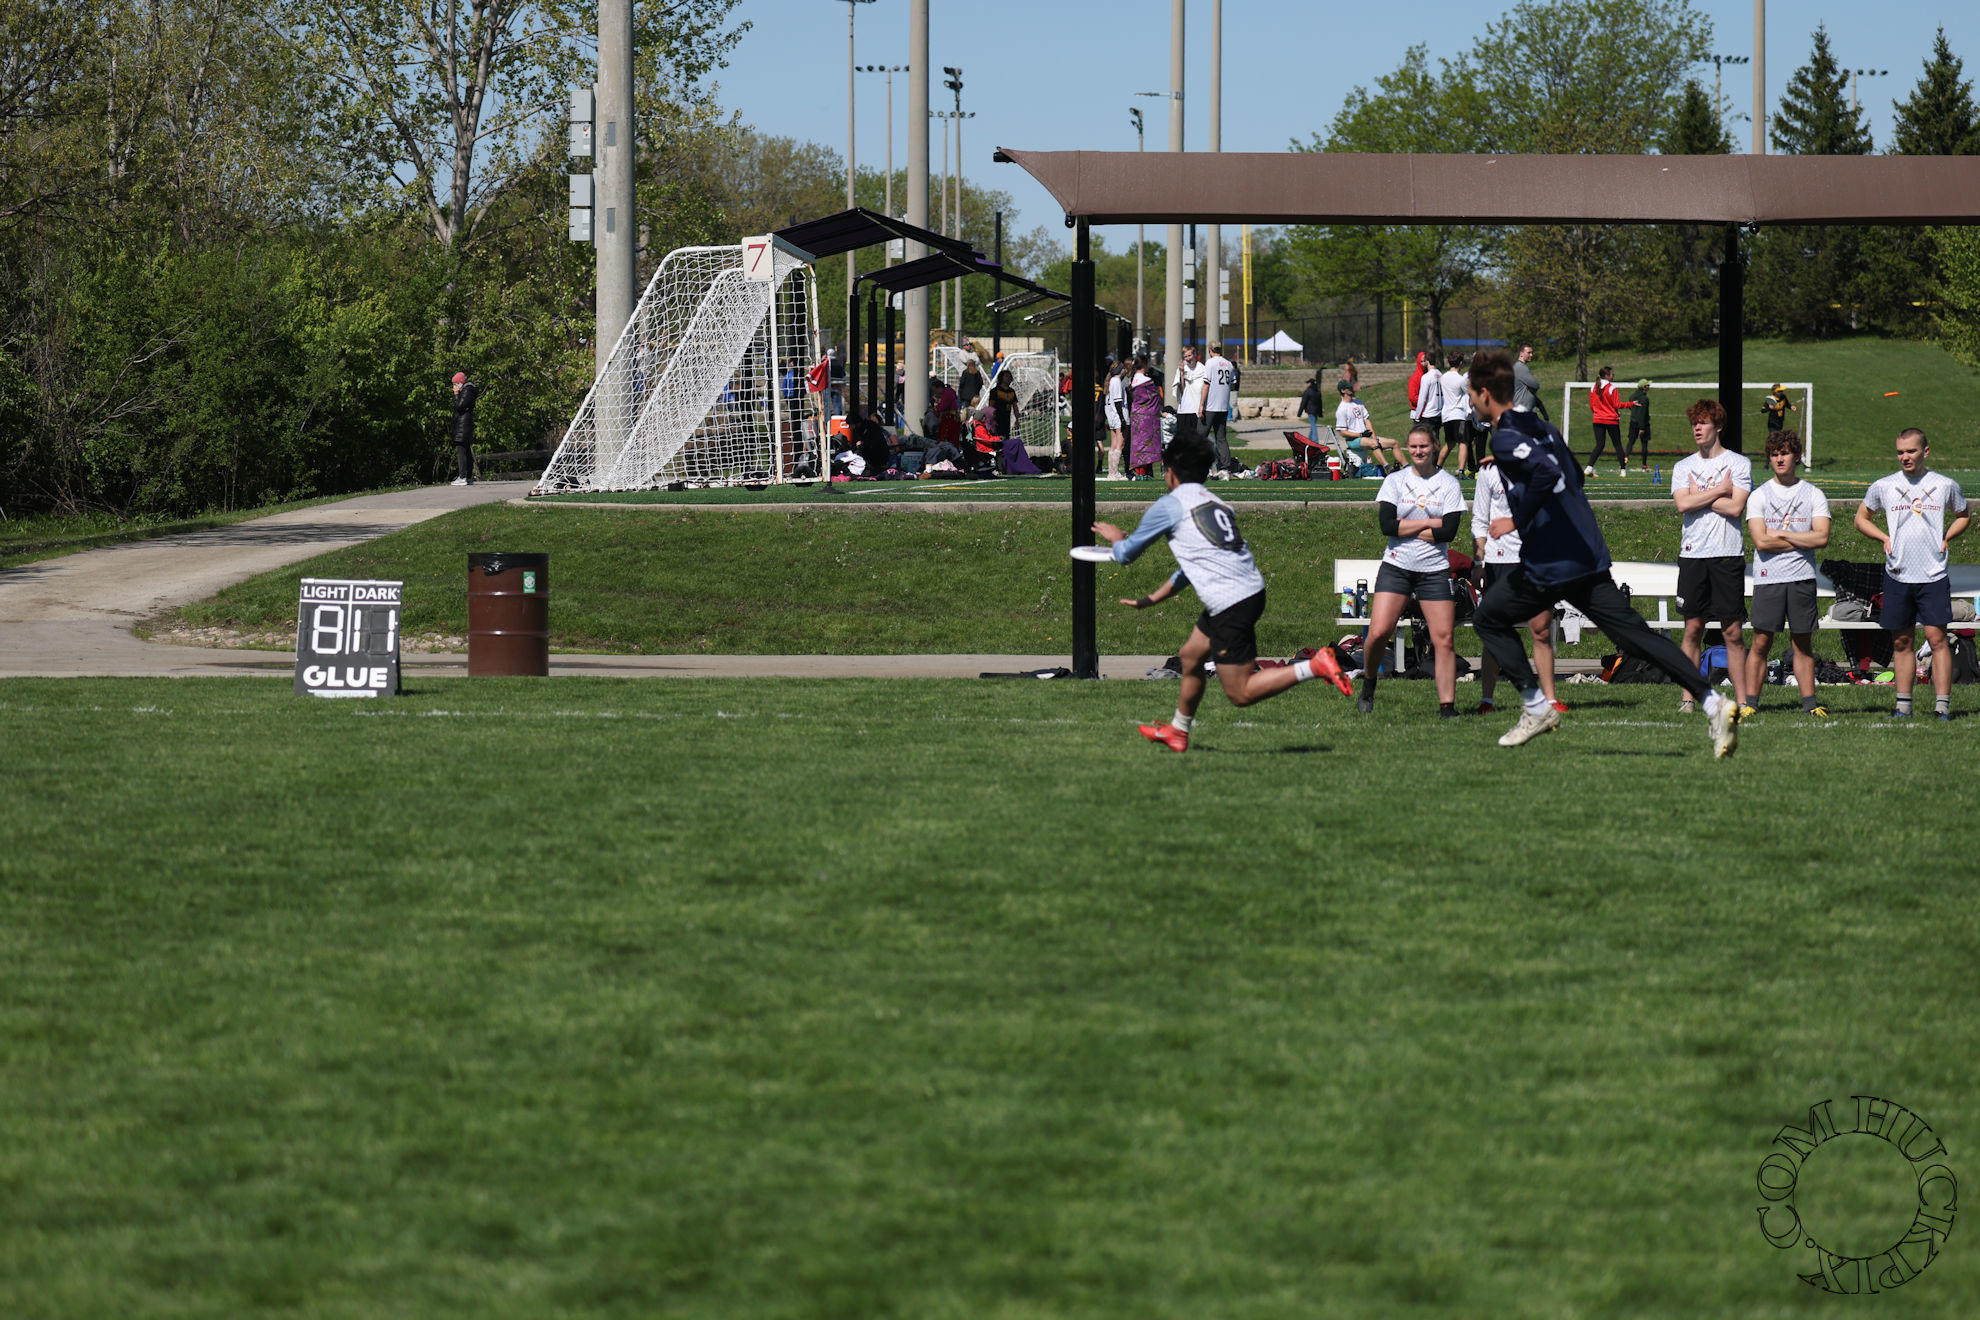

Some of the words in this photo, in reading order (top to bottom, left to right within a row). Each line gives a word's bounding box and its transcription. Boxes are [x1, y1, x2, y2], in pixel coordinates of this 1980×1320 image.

[747, 243, 767, 272] 7
[1214, 508, 1234, 542] 9
[303, 585, 348, 599] LIGHT
[355, 587, 398, 600] DARK
[312, 605, 345, 654] 8
[303, 665, 388, 688] GLUE
